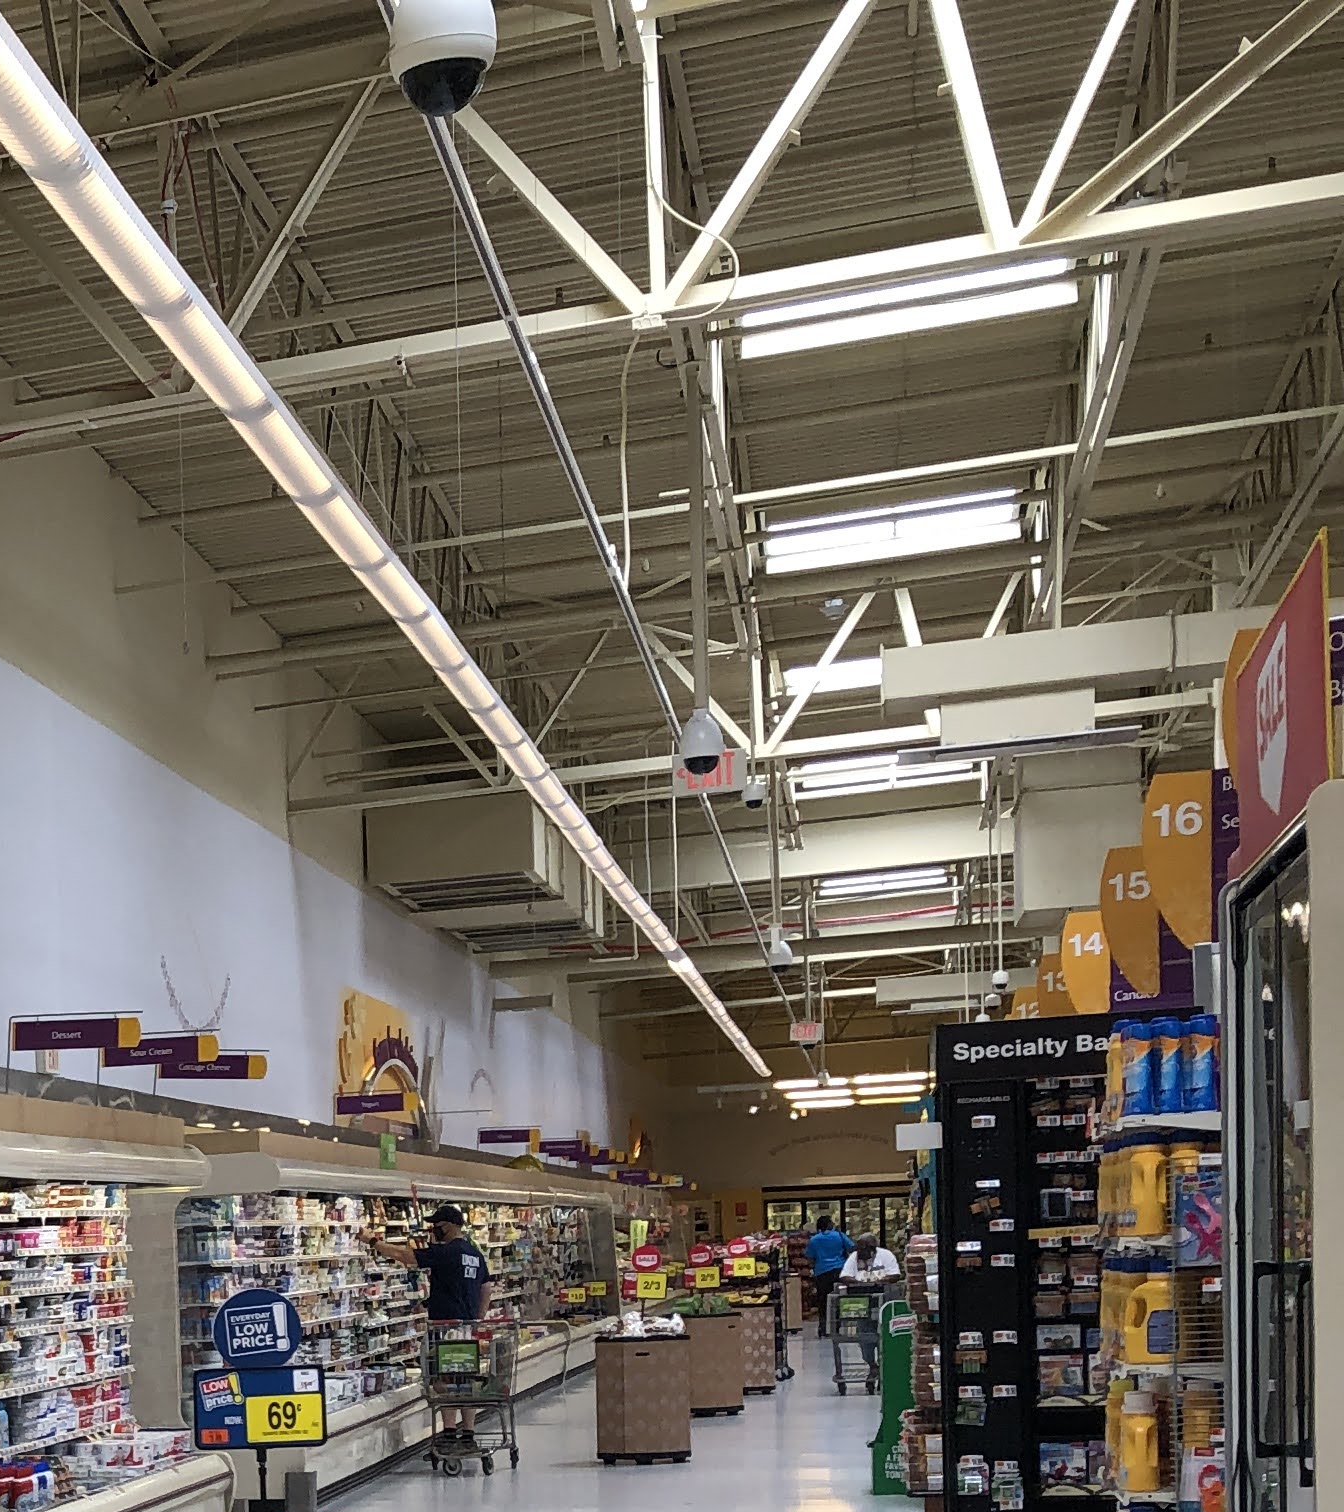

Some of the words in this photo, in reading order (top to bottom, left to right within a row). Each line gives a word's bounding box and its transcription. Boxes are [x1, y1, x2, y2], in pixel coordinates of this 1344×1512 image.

[1152, 801, 1203, 836] 16
[1109, 872, 1151, 901] 15
[1068, 932, 1103, 956] 14
[1016, 1001, 1039, 1020] 12
[52, 1031, 81, 1039] Dessert
[130, 1049, 147, 1057] Sour
[953, 1038, 1068, 1063] Specialty
[230, 1312, 271, 1323] EVERYDAY
[235, 1322, 268, 1337] LOW
[232, 1334, 275, 1349] PRICE
[202, 1379, 228, 1393] LOW
[206, 1394, 233, 1409] price
